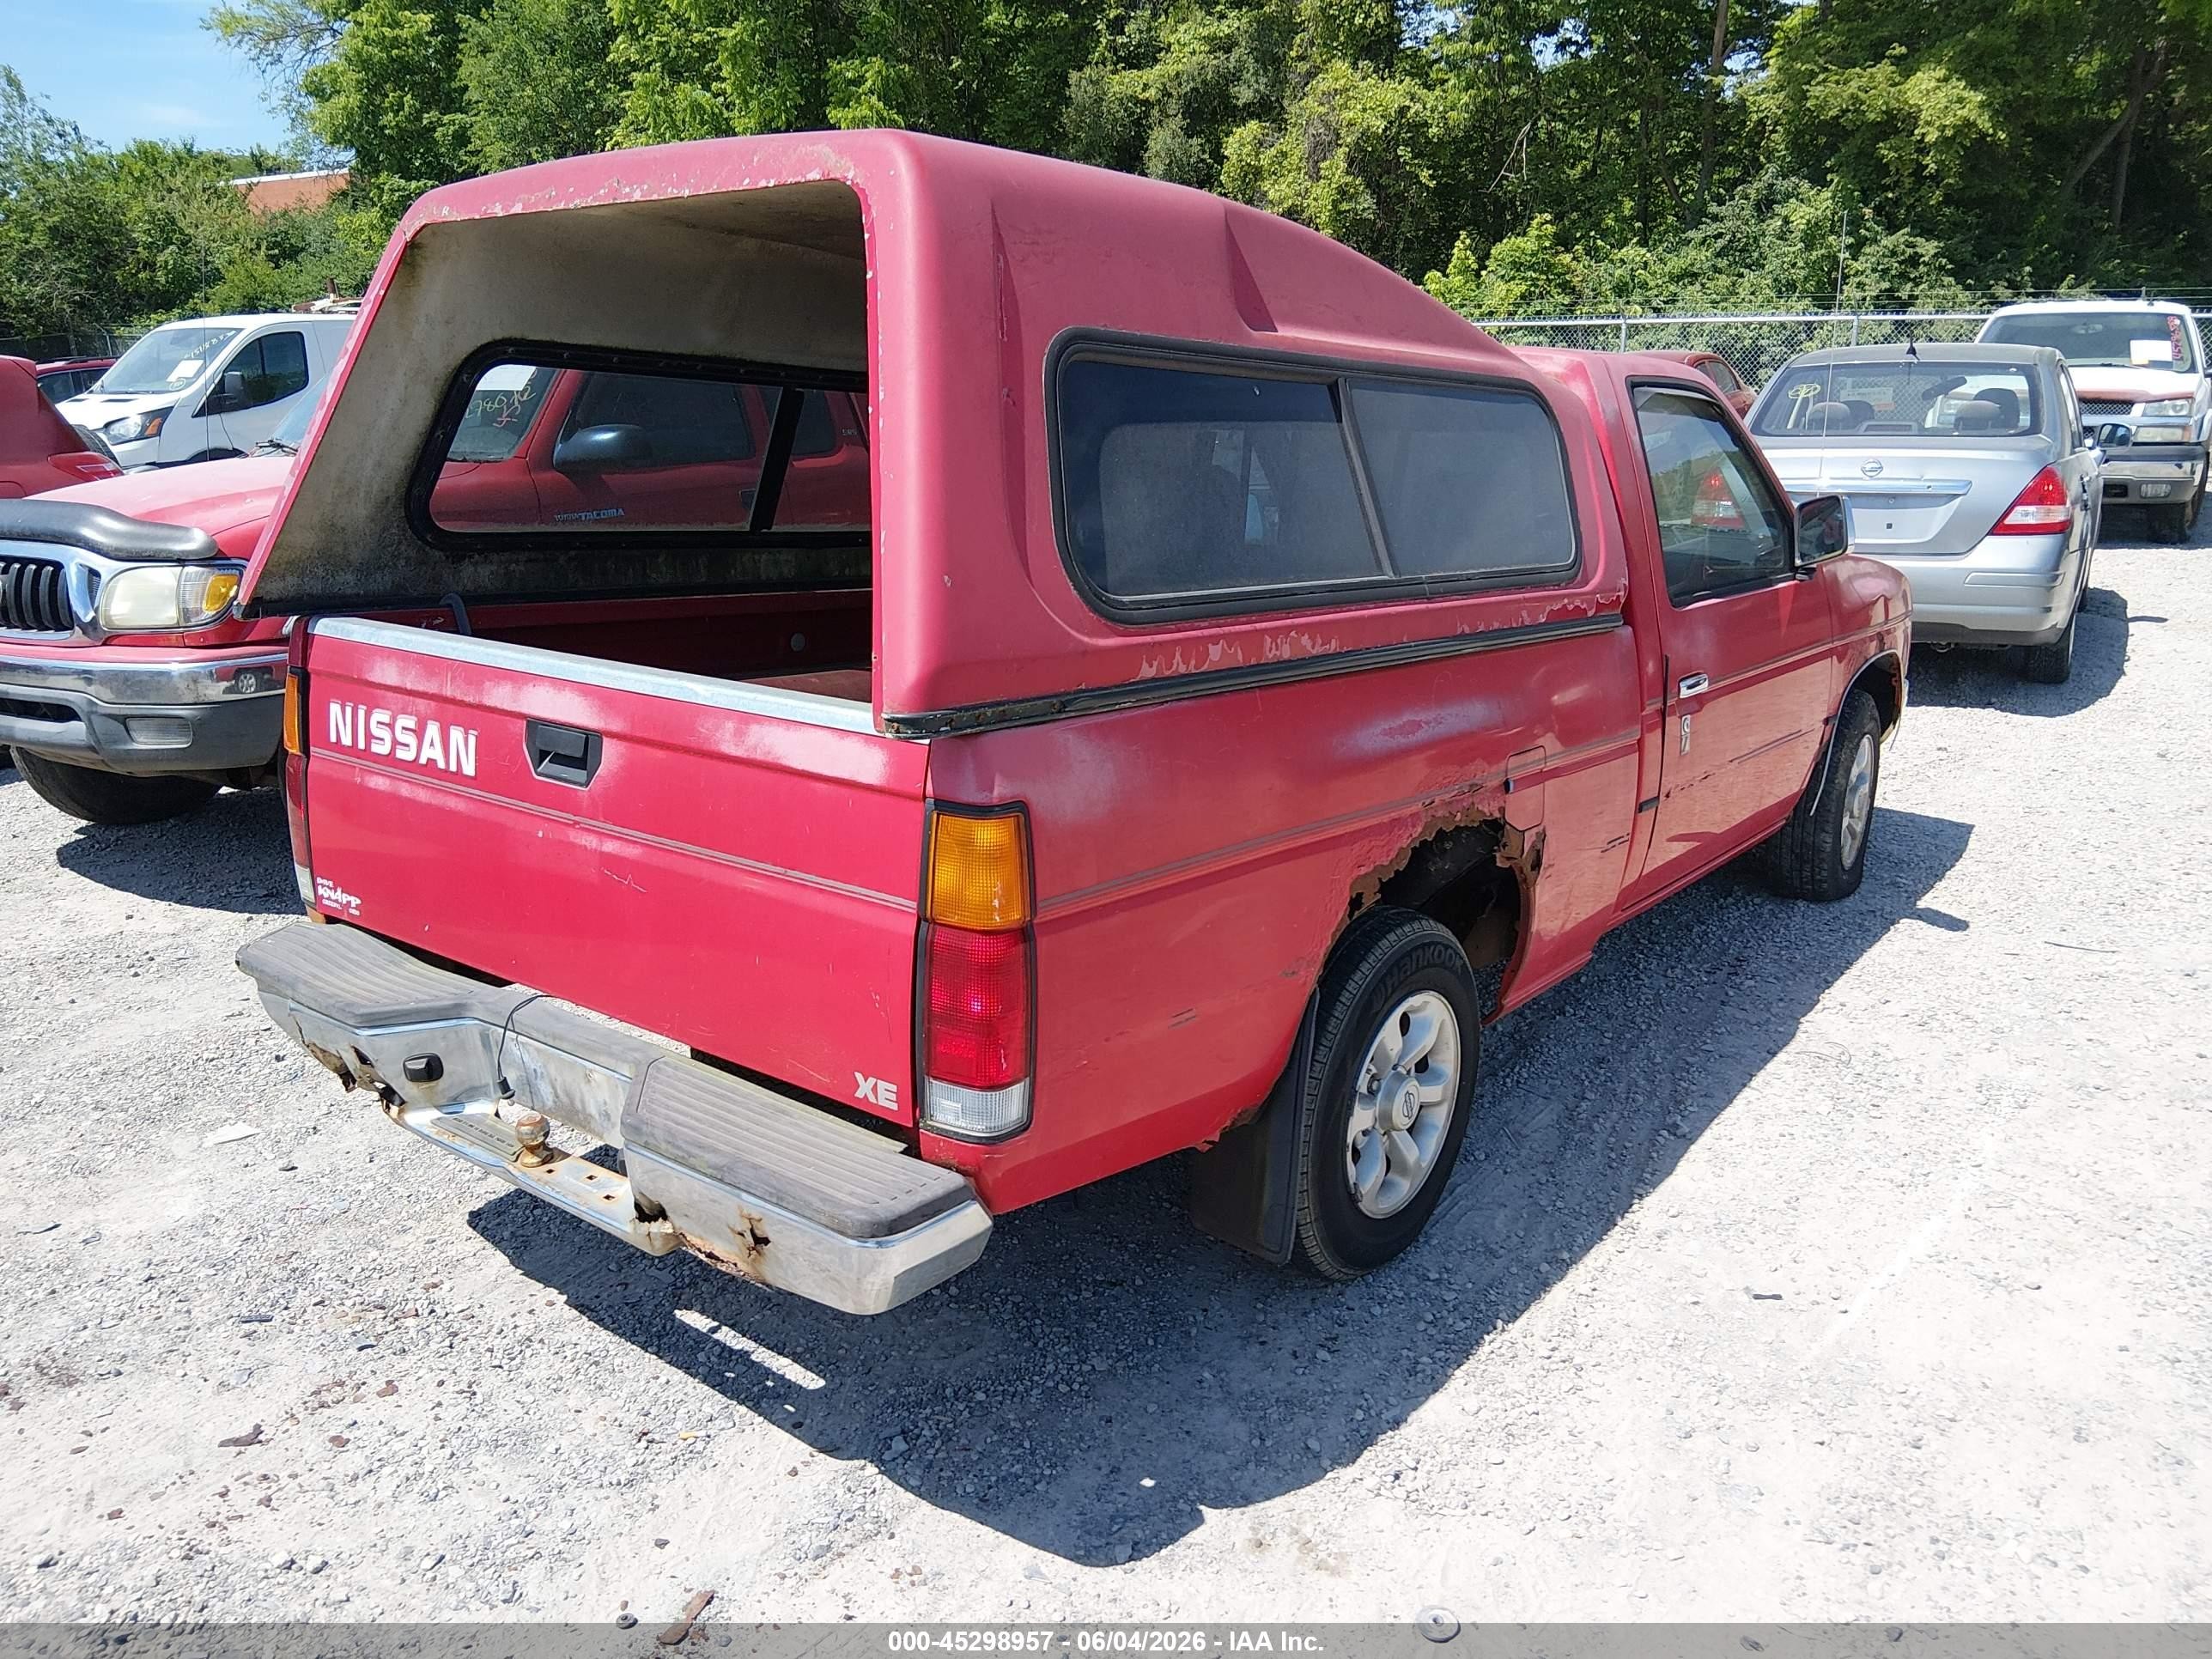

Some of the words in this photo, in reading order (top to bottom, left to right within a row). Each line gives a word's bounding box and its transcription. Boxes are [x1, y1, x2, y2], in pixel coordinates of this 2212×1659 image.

[578, 507, 625, 521] TACOMA
[328, 698, 479, 778] NISSAN
[317, 884, 362, 908] KNAPP
[854, 1071, 899, 1111] XE
